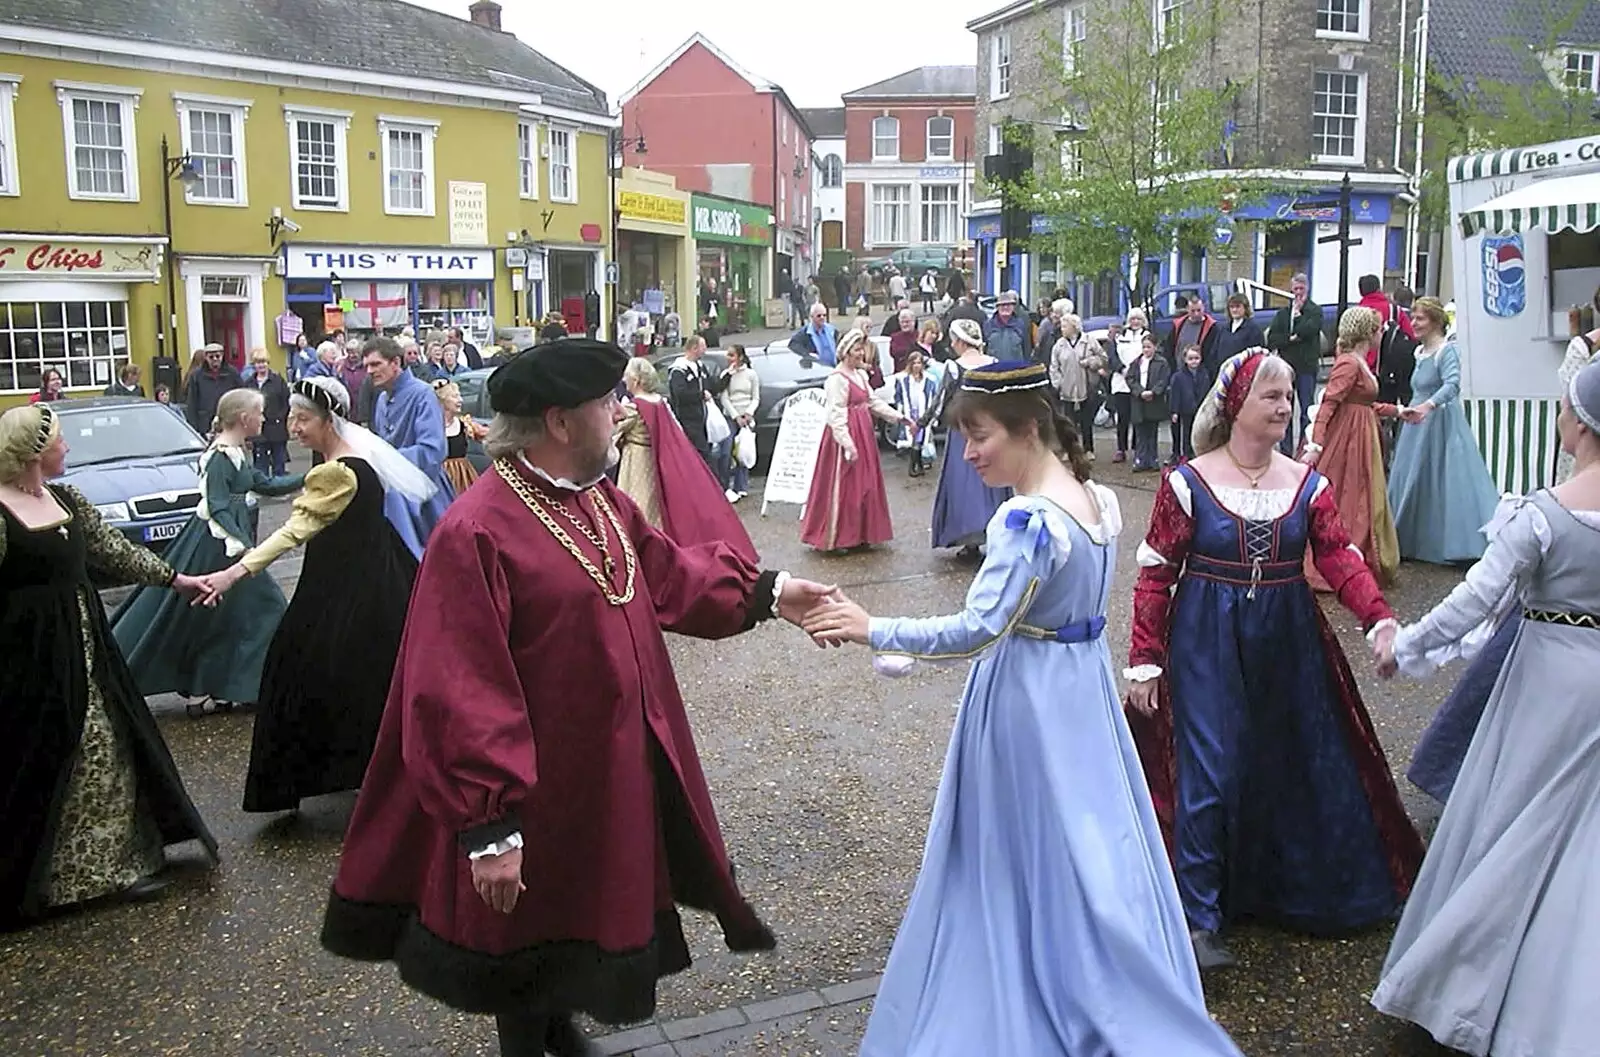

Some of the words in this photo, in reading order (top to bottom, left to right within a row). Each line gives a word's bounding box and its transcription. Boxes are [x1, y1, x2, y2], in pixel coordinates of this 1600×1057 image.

[1523, 150, 1559, 169] Tea
[26, 243, 104, 271] Chips
[304, 252, 376, 269] THIS
[407, 254, 479, 271] THAT
[1485, 246, 1500, 314] PEPSI
